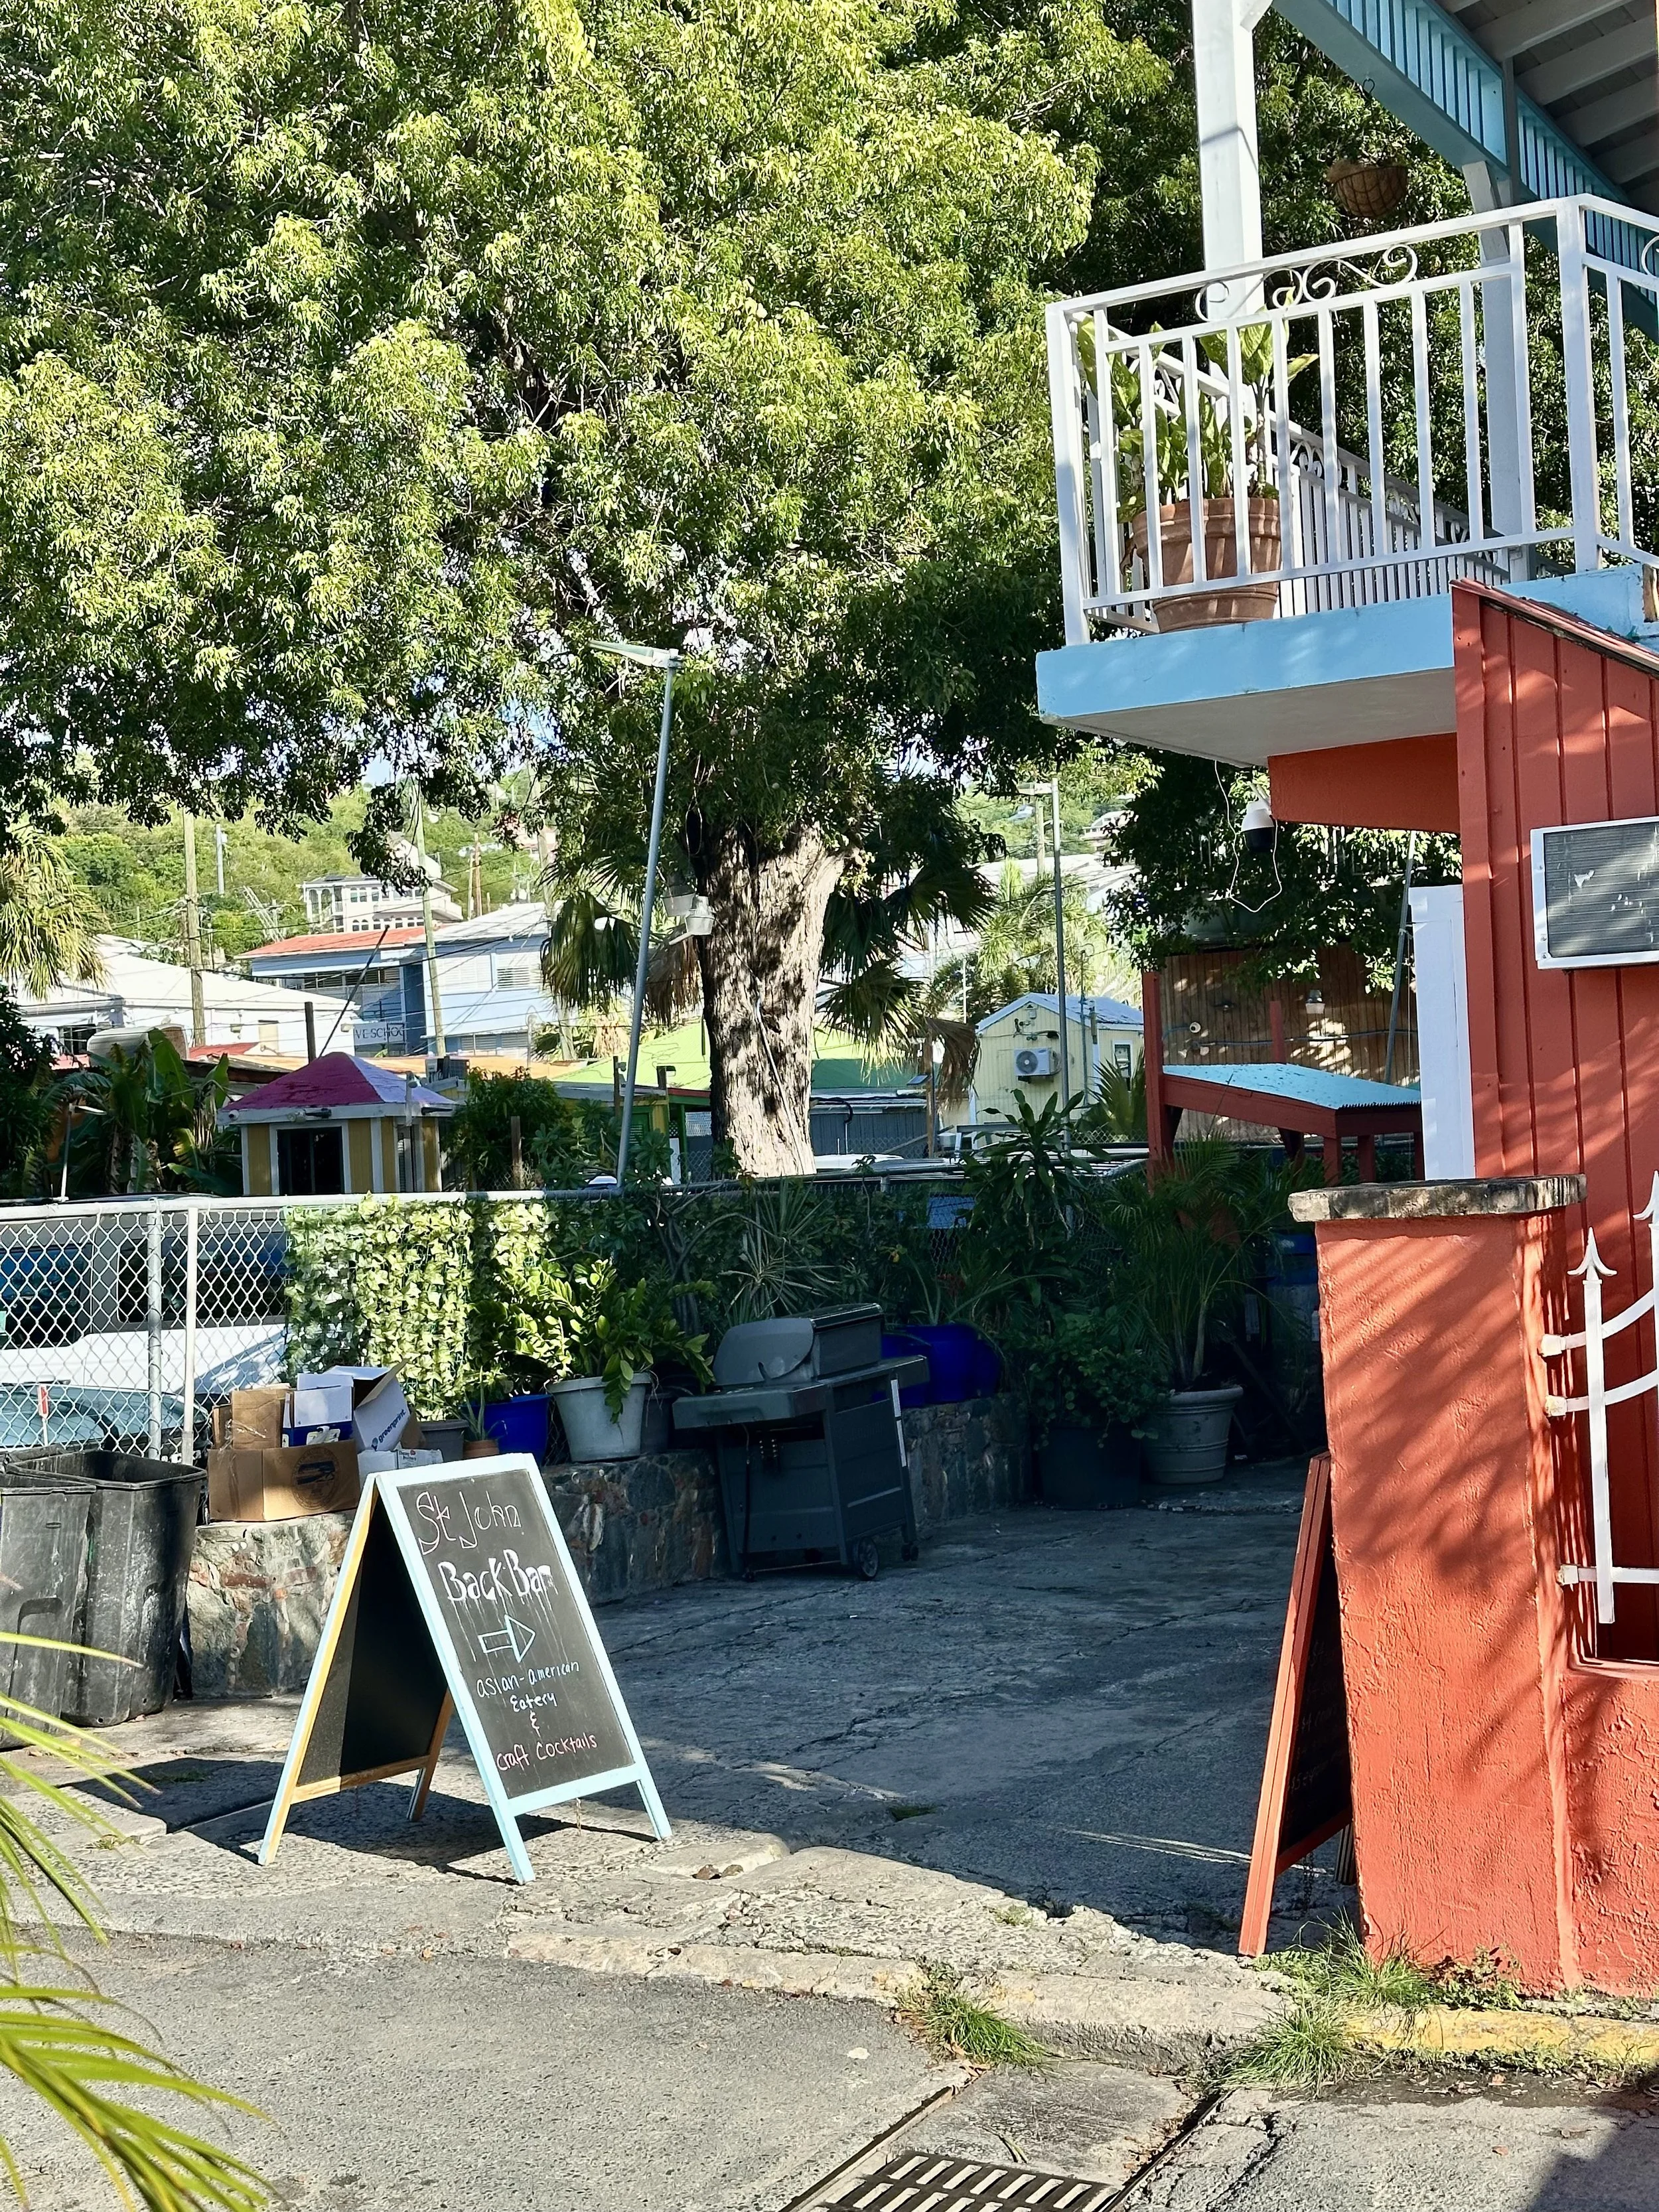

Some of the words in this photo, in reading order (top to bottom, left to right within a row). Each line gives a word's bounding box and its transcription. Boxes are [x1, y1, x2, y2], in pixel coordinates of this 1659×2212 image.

[378, 1408, 407, 1443] greenprint
[415, 1491, 457, 1556] St
[459, 1490, 522, 1549] John
[437, 1557, 513, 1601] Back
[503, 1548, 555, 1598] Bar
[510, 1692, 557, 1713] Eatery
